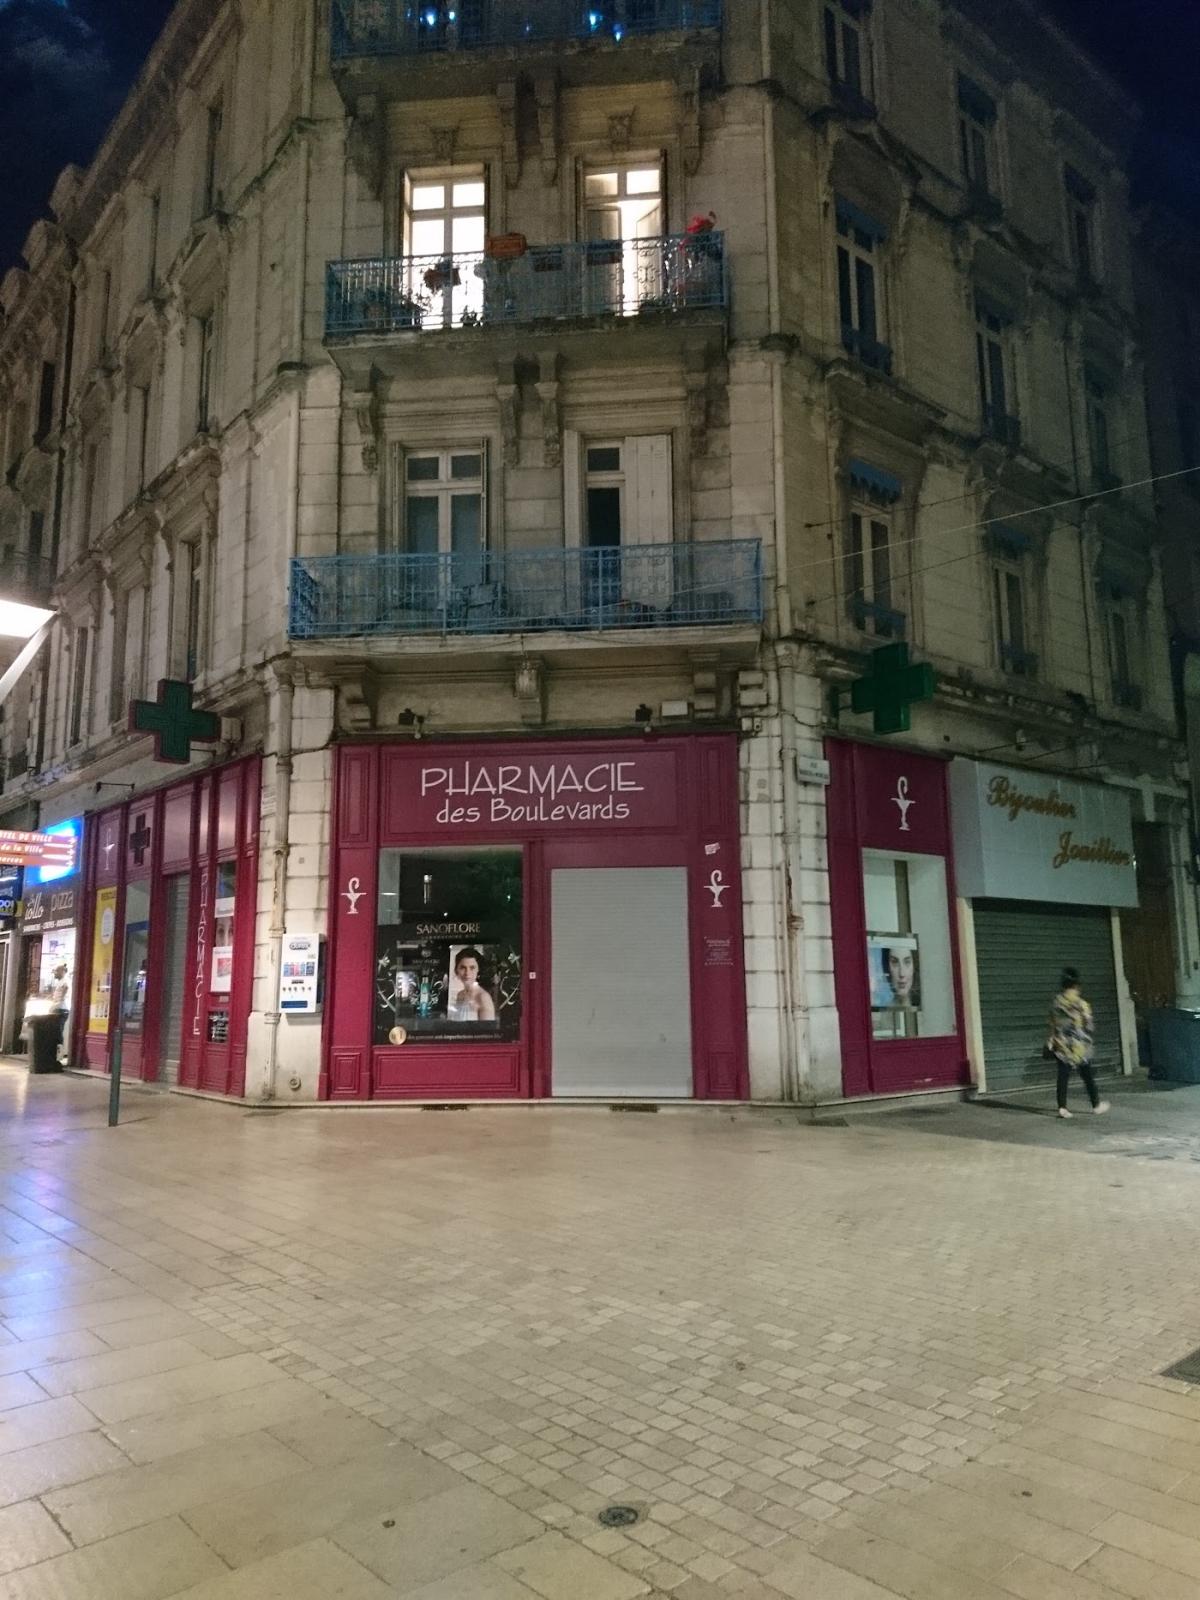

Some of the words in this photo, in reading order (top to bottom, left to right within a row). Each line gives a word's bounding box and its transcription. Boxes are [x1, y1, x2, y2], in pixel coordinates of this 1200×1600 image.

[421, 761, 644, 800] PHARMACIE
[436, 798, 481, 823] des
[490, 795, 630, 822] Boulevards
[416, 922, 480, 935] SANOFLORE
[193, 873, 209, 1035] PHARMACIE
